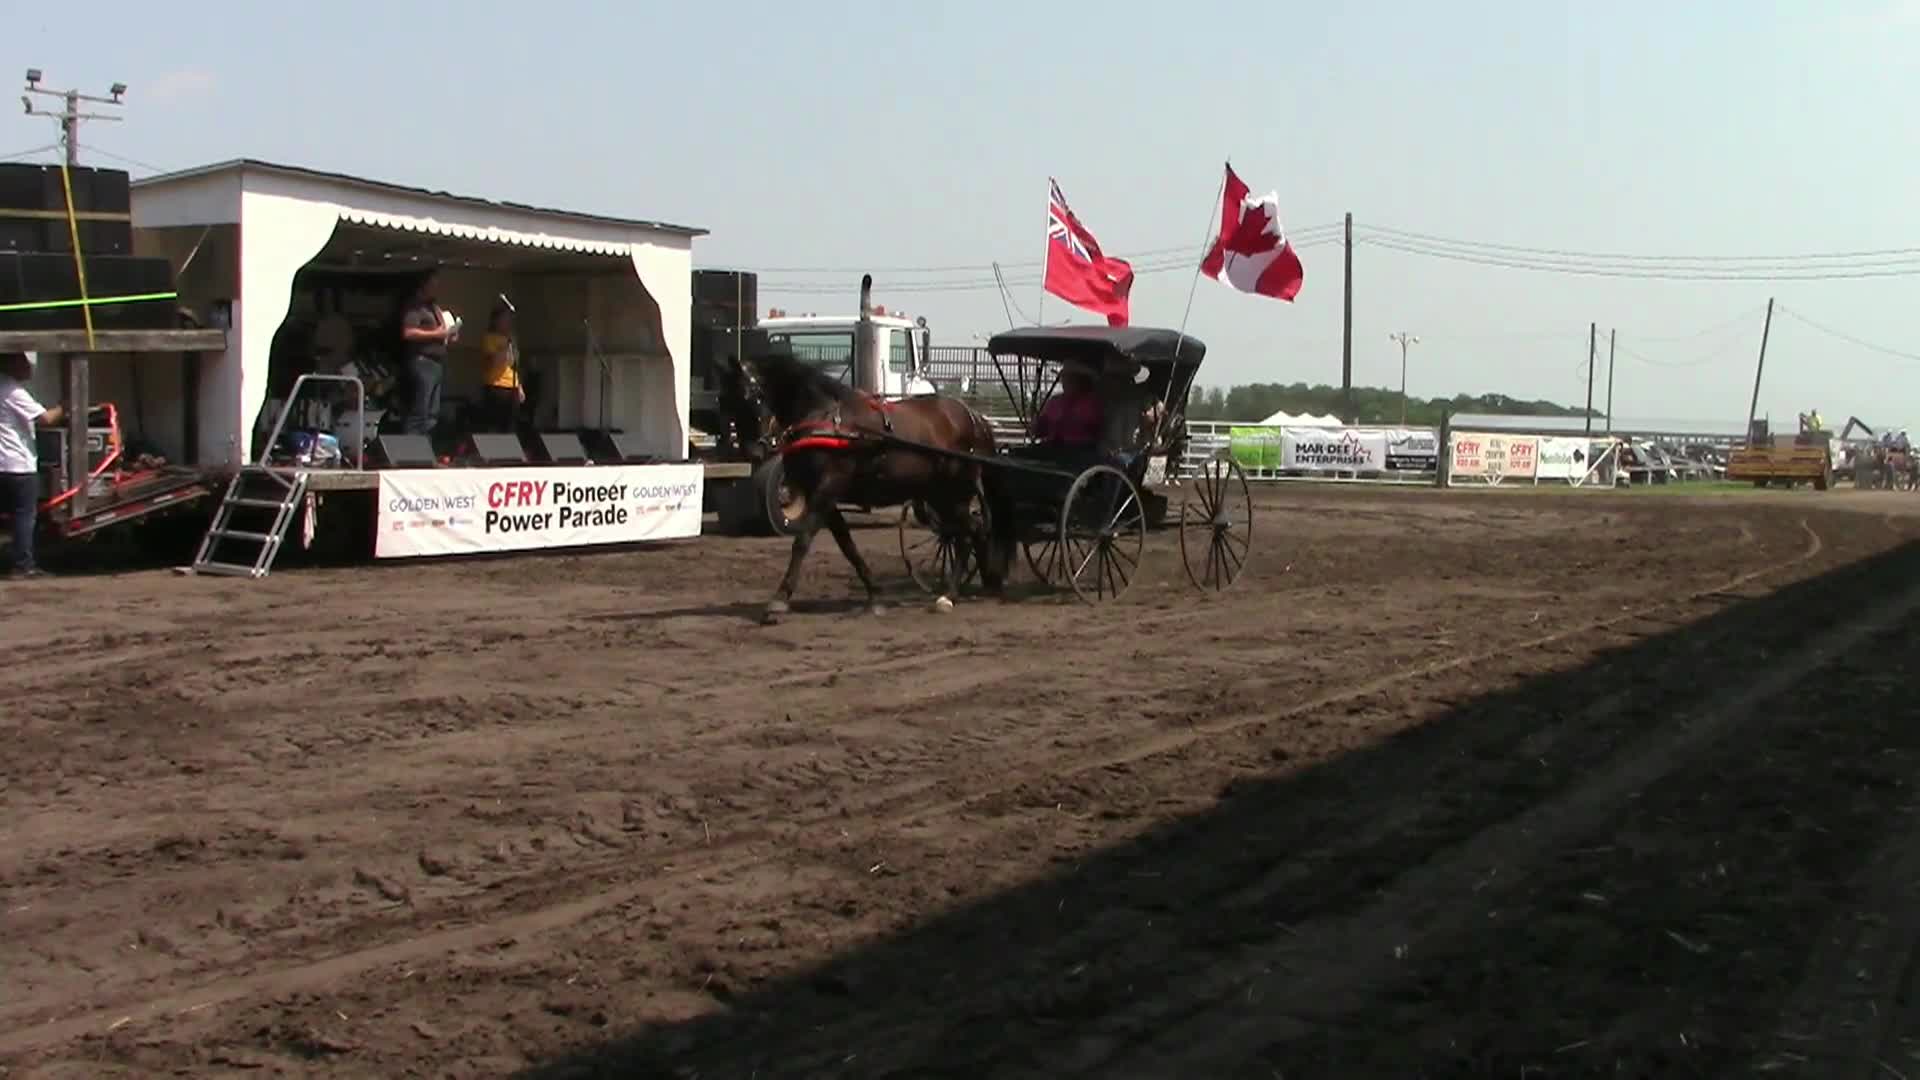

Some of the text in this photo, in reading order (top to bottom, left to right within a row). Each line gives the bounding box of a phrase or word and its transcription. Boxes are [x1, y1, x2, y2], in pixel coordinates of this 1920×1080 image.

[1296, 443, 1350, 455] MAR DEE
[1456, 441, 1480, 455] CFRY
[1510, 443, 1534, 457] CFRY
[1295, 454, 1364, 465] ENTERPRISES
[488, 480, 627, 508] CFRY Pioneer
[633, 483, 697, 498] GOLDEN WEST
[389, 495, 475, 512] GOLDEN WEST
[485, 503, 627, 534] Power Parade
